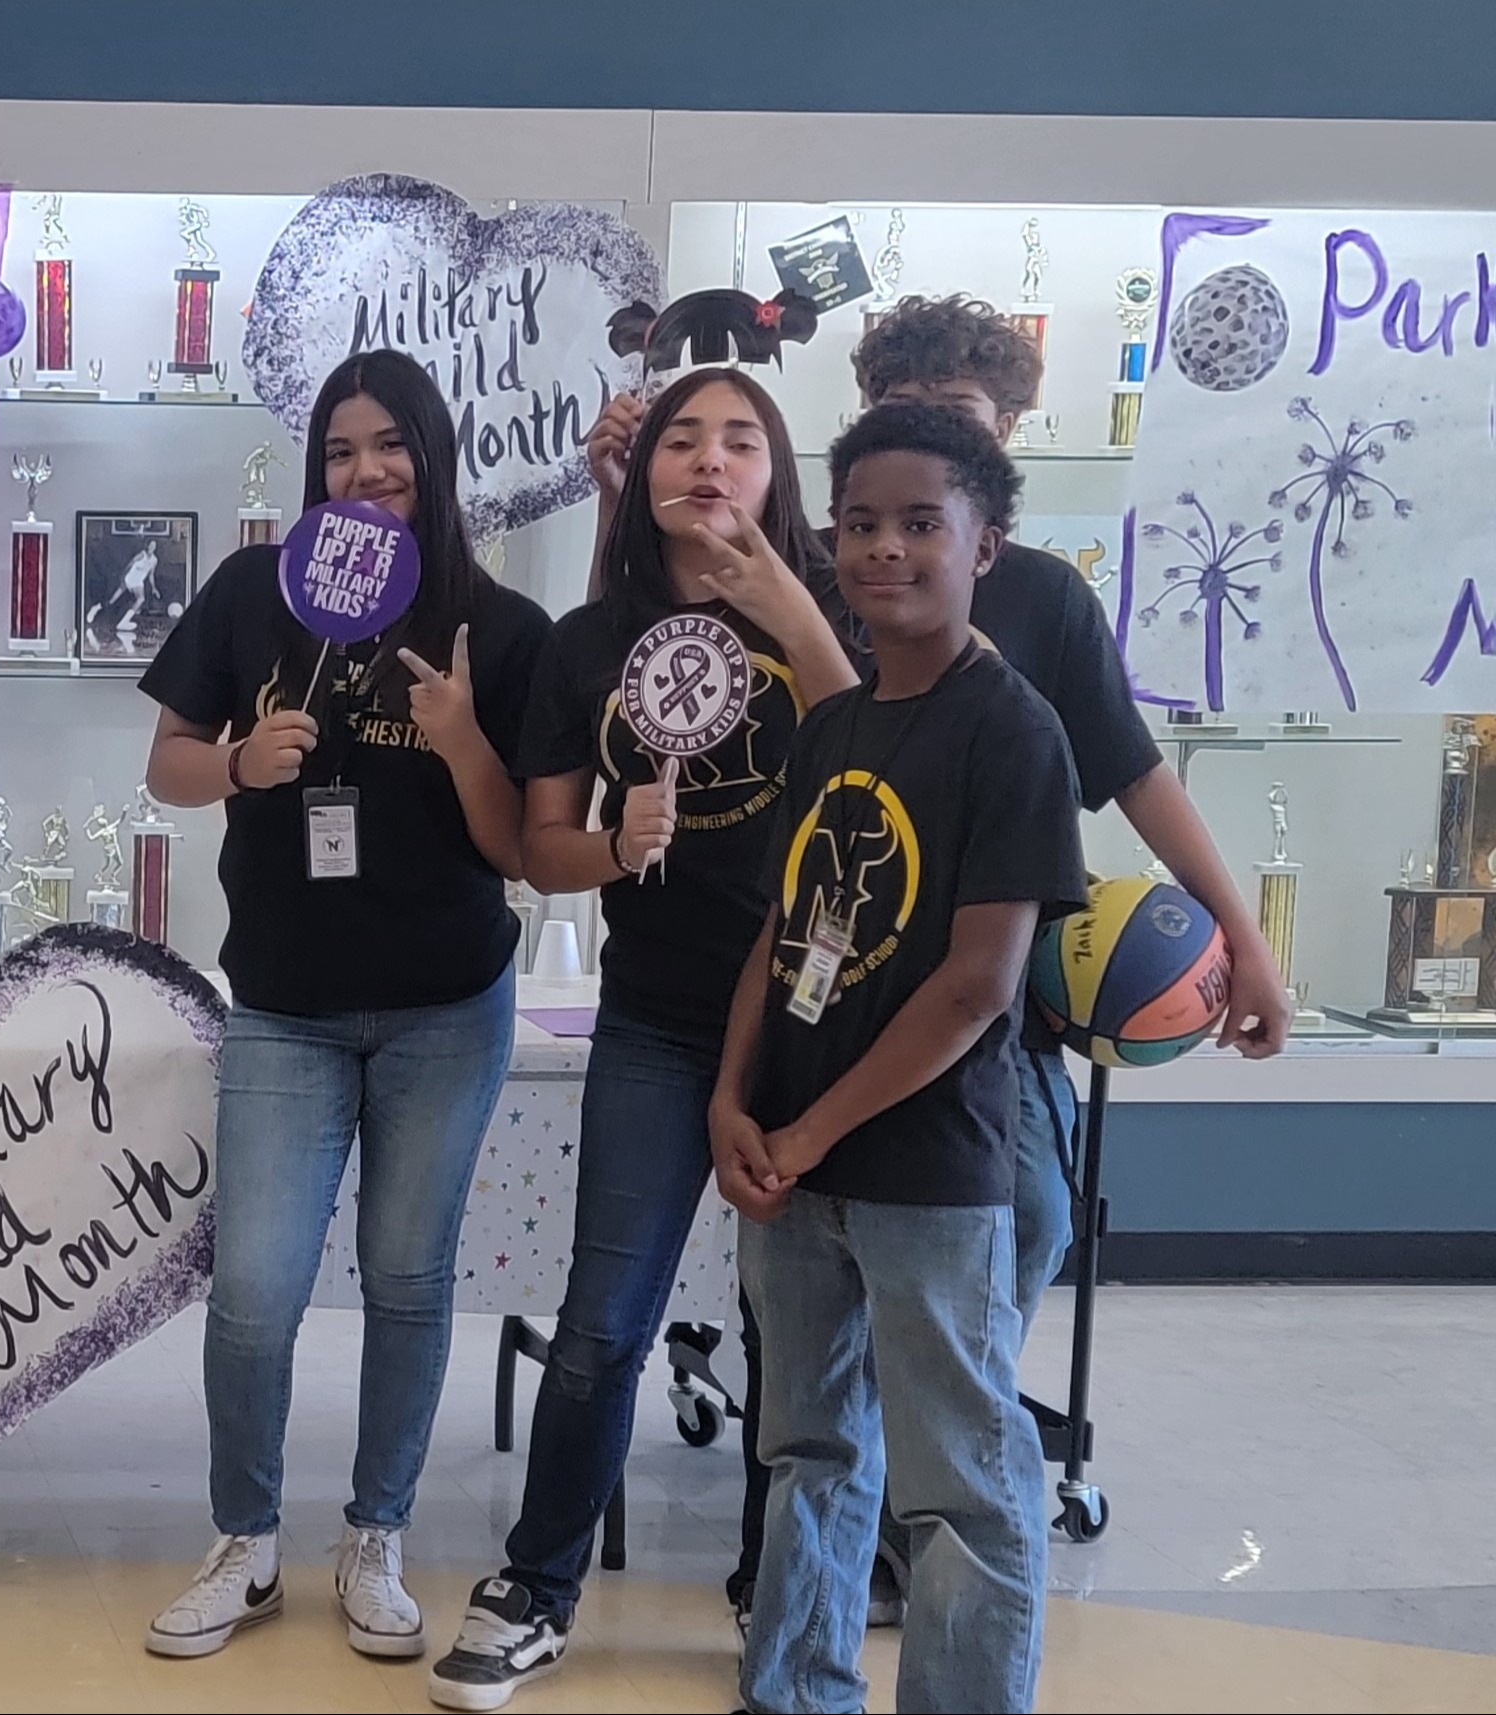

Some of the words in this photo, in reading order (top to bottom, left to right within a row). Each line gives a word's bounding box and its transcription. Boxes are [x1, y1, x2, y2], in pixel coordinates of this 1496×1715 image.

[350, 257, 549, 353] Military
[312, 534, 347, 565] UP
[319, 511, 401, 556] PURPLE
[304, 560, 387, 599] MILITARY
[312, 584, 365, 618] KIDS
[644, 619, 722, 652] PURPLE
[722, 639, 743, 667] UP
[626, 678, 641, 712] FOR
[634, 713, 708, 750] MILITARY
[710, 697, 742, 737] KIDS
[743, 782, 781, 817] MIDDLE
[864, 934, 899, 971] SCHOOL
